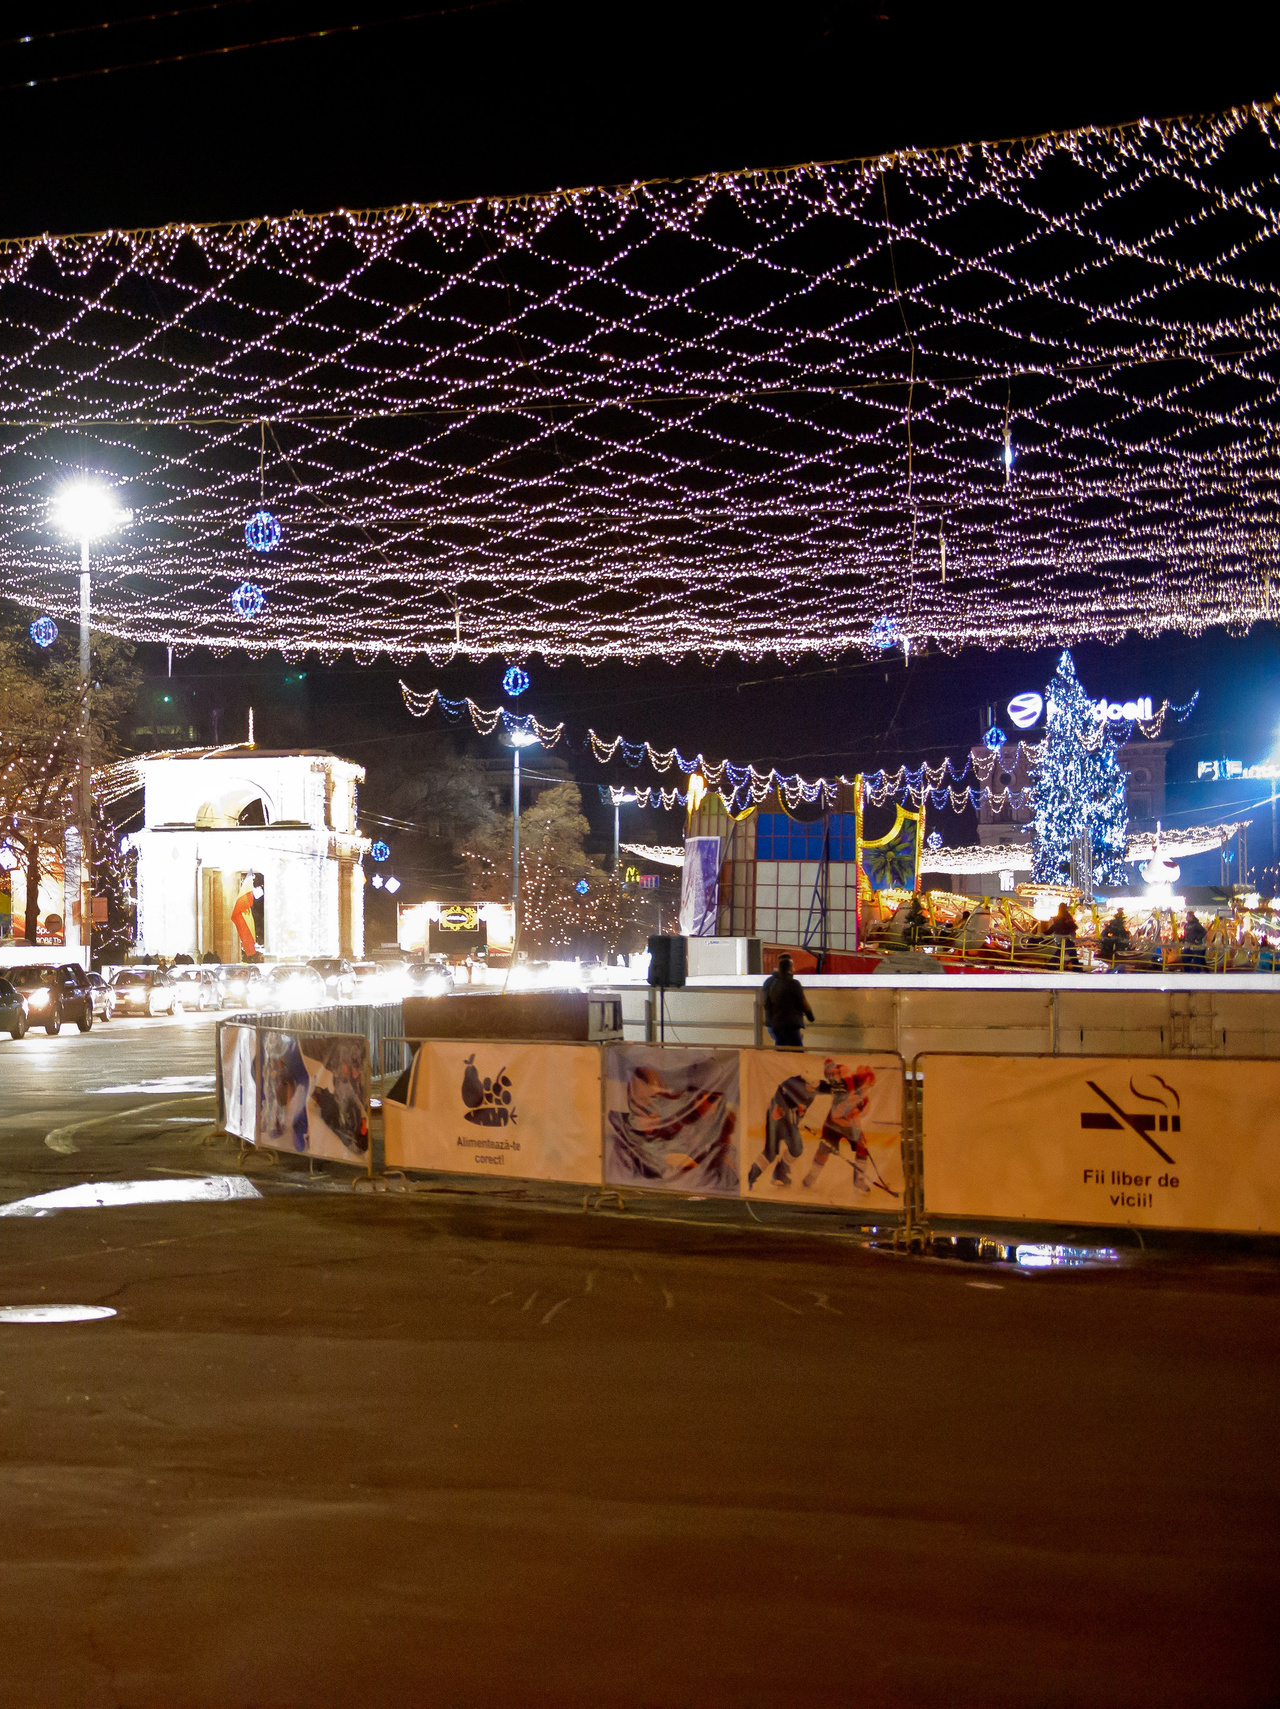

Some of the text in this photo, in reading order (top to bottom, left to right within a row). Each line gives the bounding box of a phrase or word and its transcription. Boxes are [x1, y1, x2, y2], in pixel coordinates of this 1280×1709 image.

[457, 1136, 521, 1151] Alimentează-te
[474, 1154, 505, 1165] corect!
[1083, 1169, 1180, 1188] Fii liber de
[1109, 1192, 1153, 1208] vicii!
